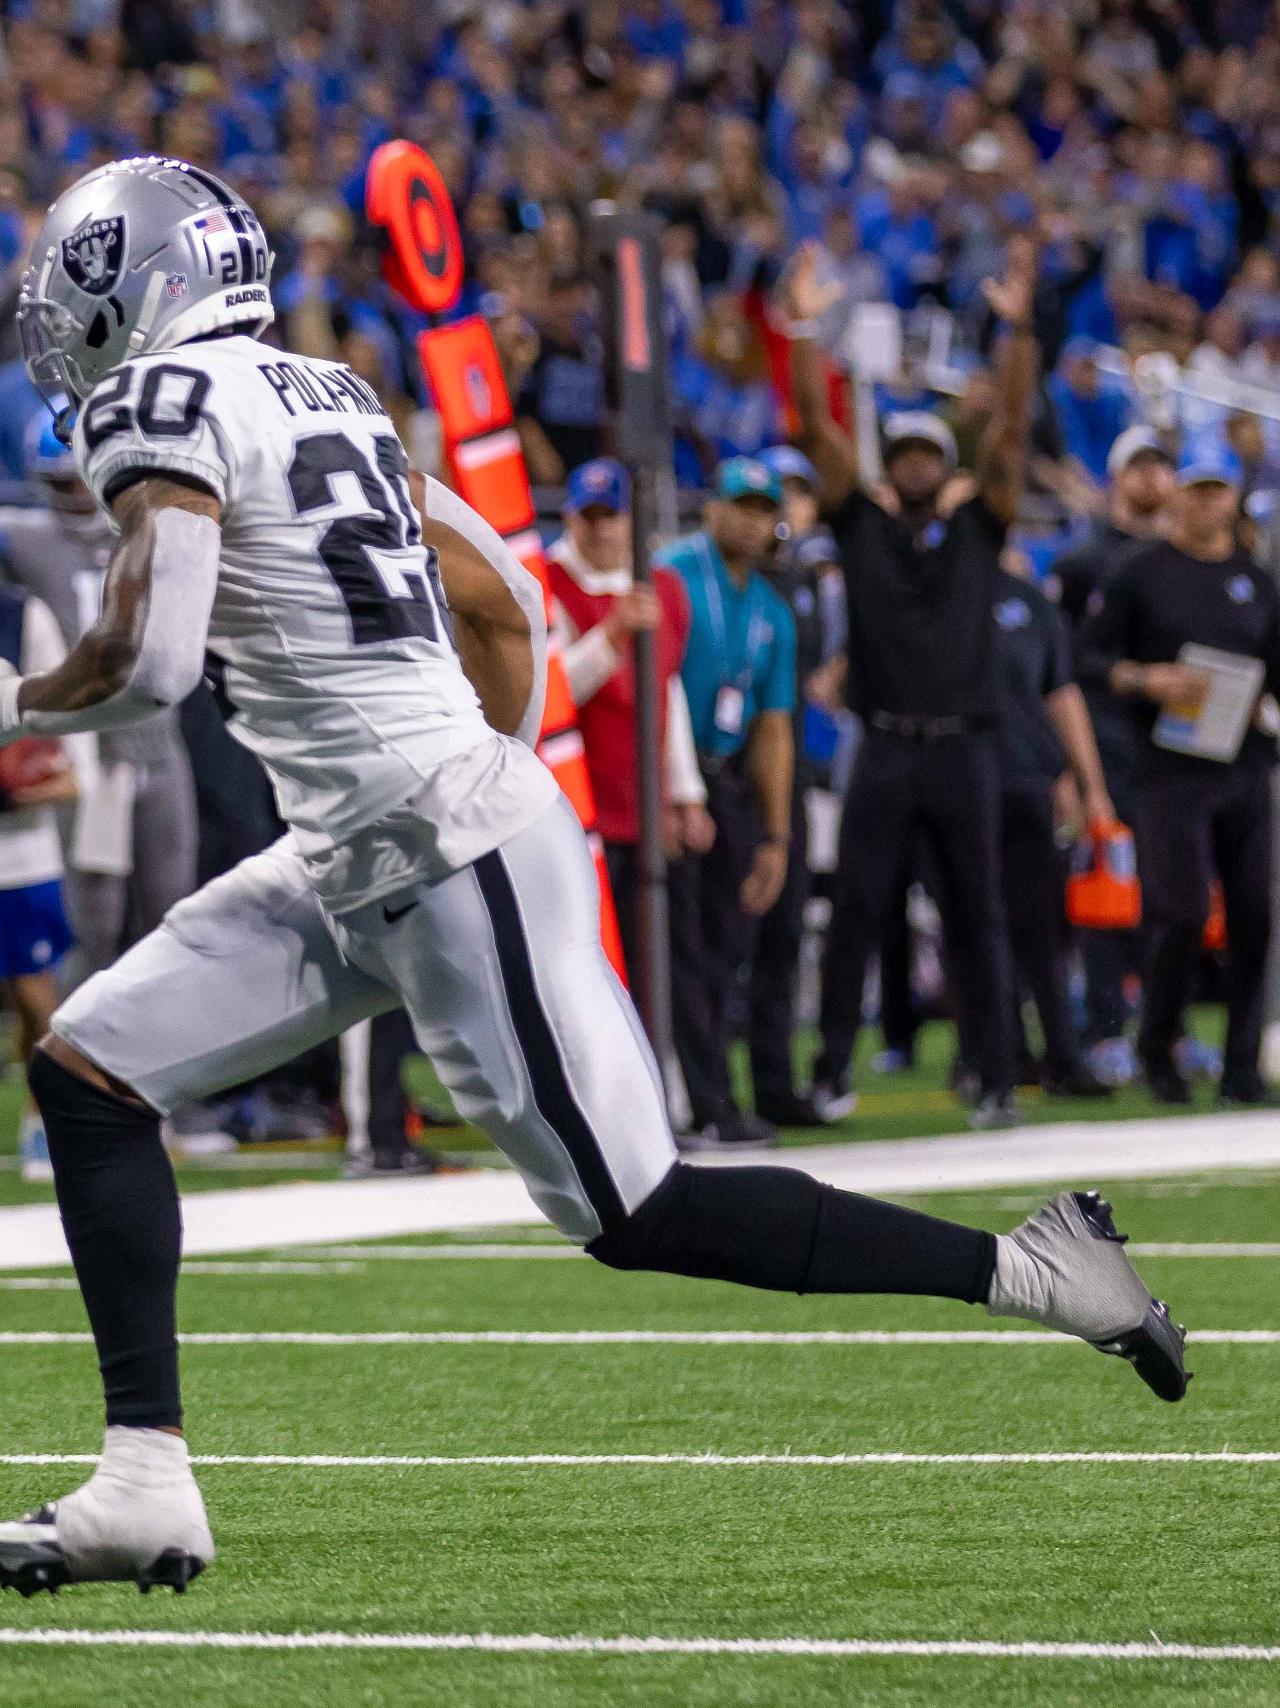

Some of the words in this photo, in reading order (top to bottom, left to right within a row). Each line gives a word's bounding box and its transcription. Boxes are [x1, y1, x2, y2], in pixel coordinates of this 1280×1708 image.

[66, 219, 119, 247] RAIDERS
[225, 288, 267, 308] RAIDERS
[82, 361, 214, 450] 20
